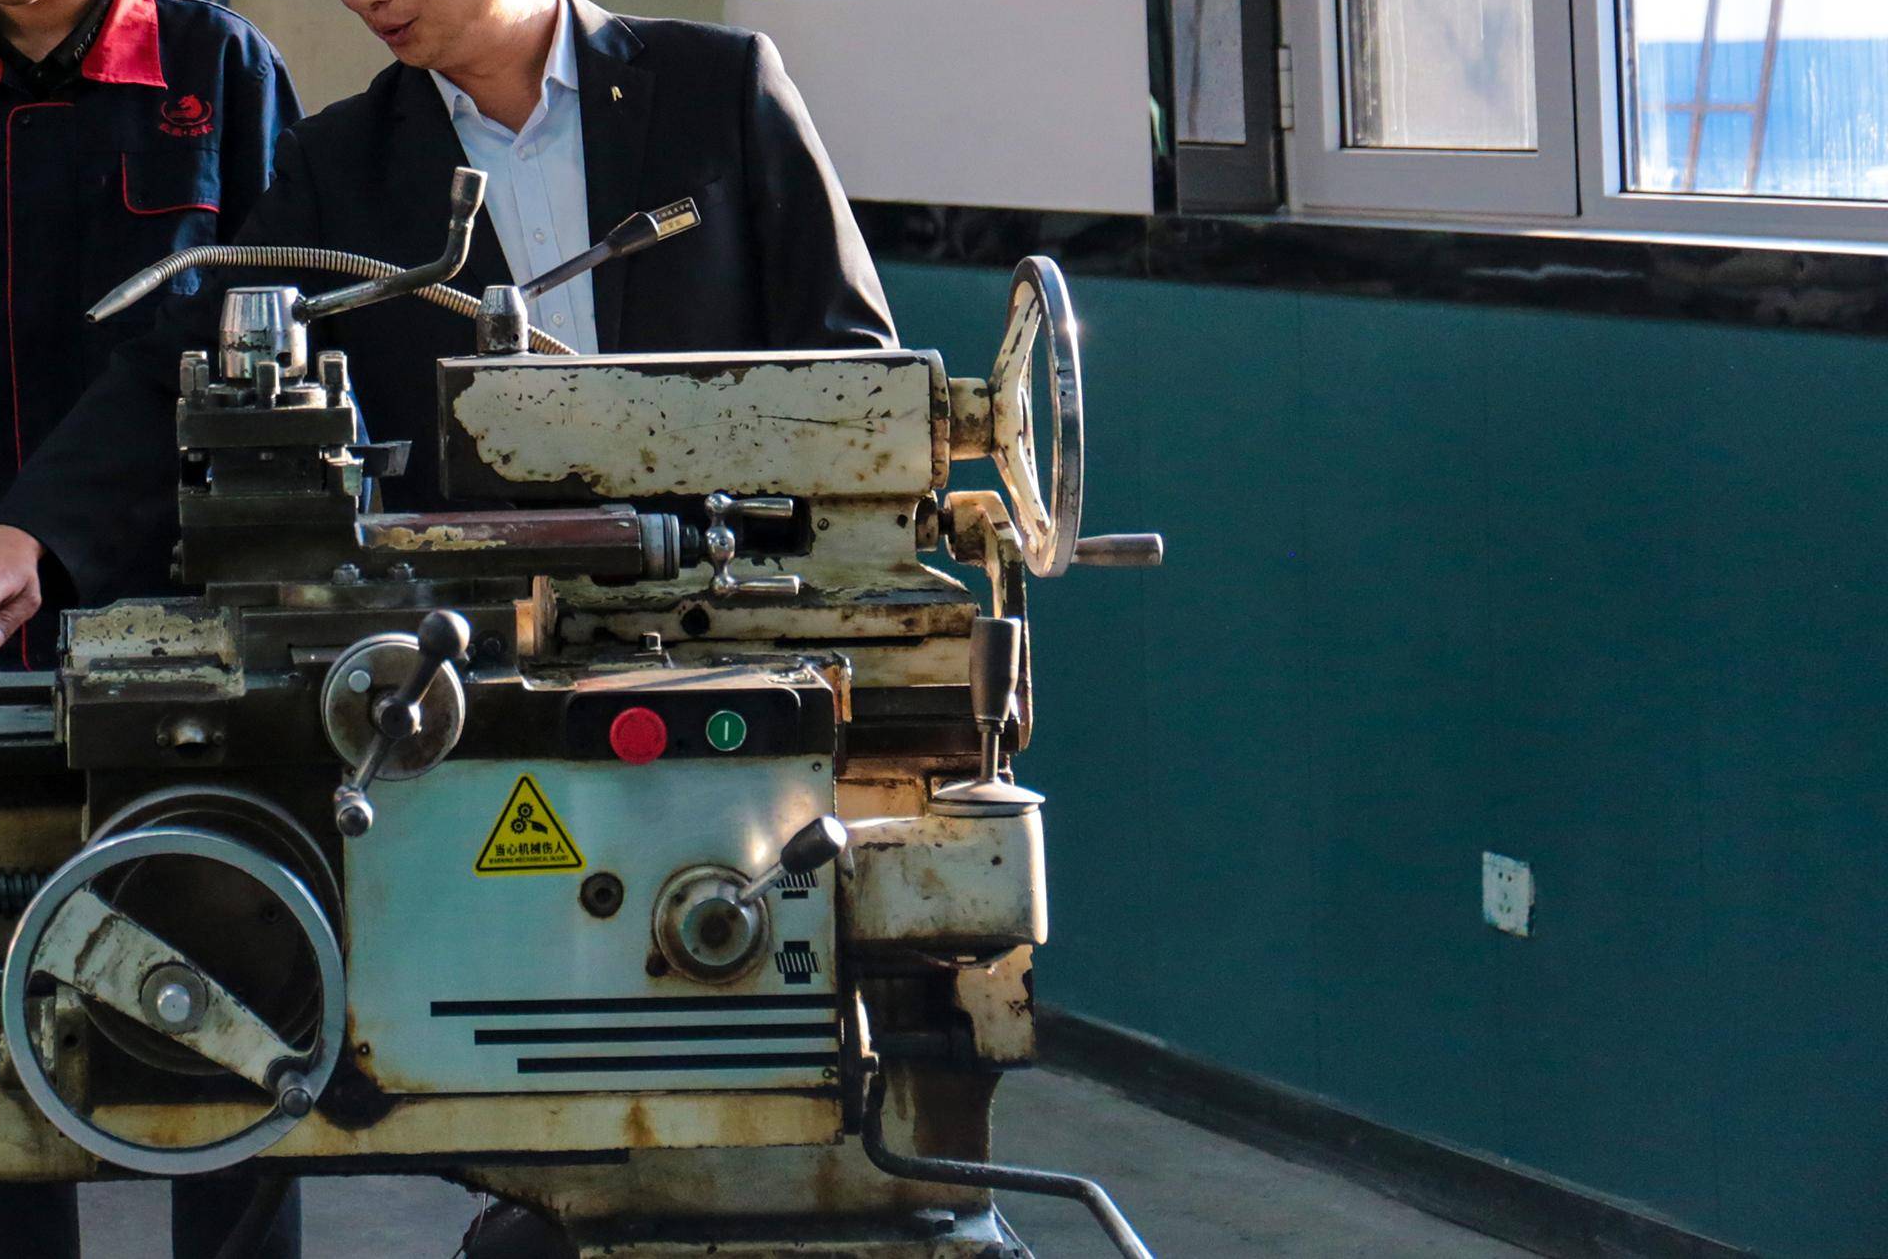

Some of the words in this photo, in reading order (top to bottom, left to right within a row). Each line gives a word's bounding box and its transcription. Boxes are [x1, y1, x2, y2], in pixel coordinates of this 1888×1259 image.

[495, 841, 565, 856] 当心机械伤人
